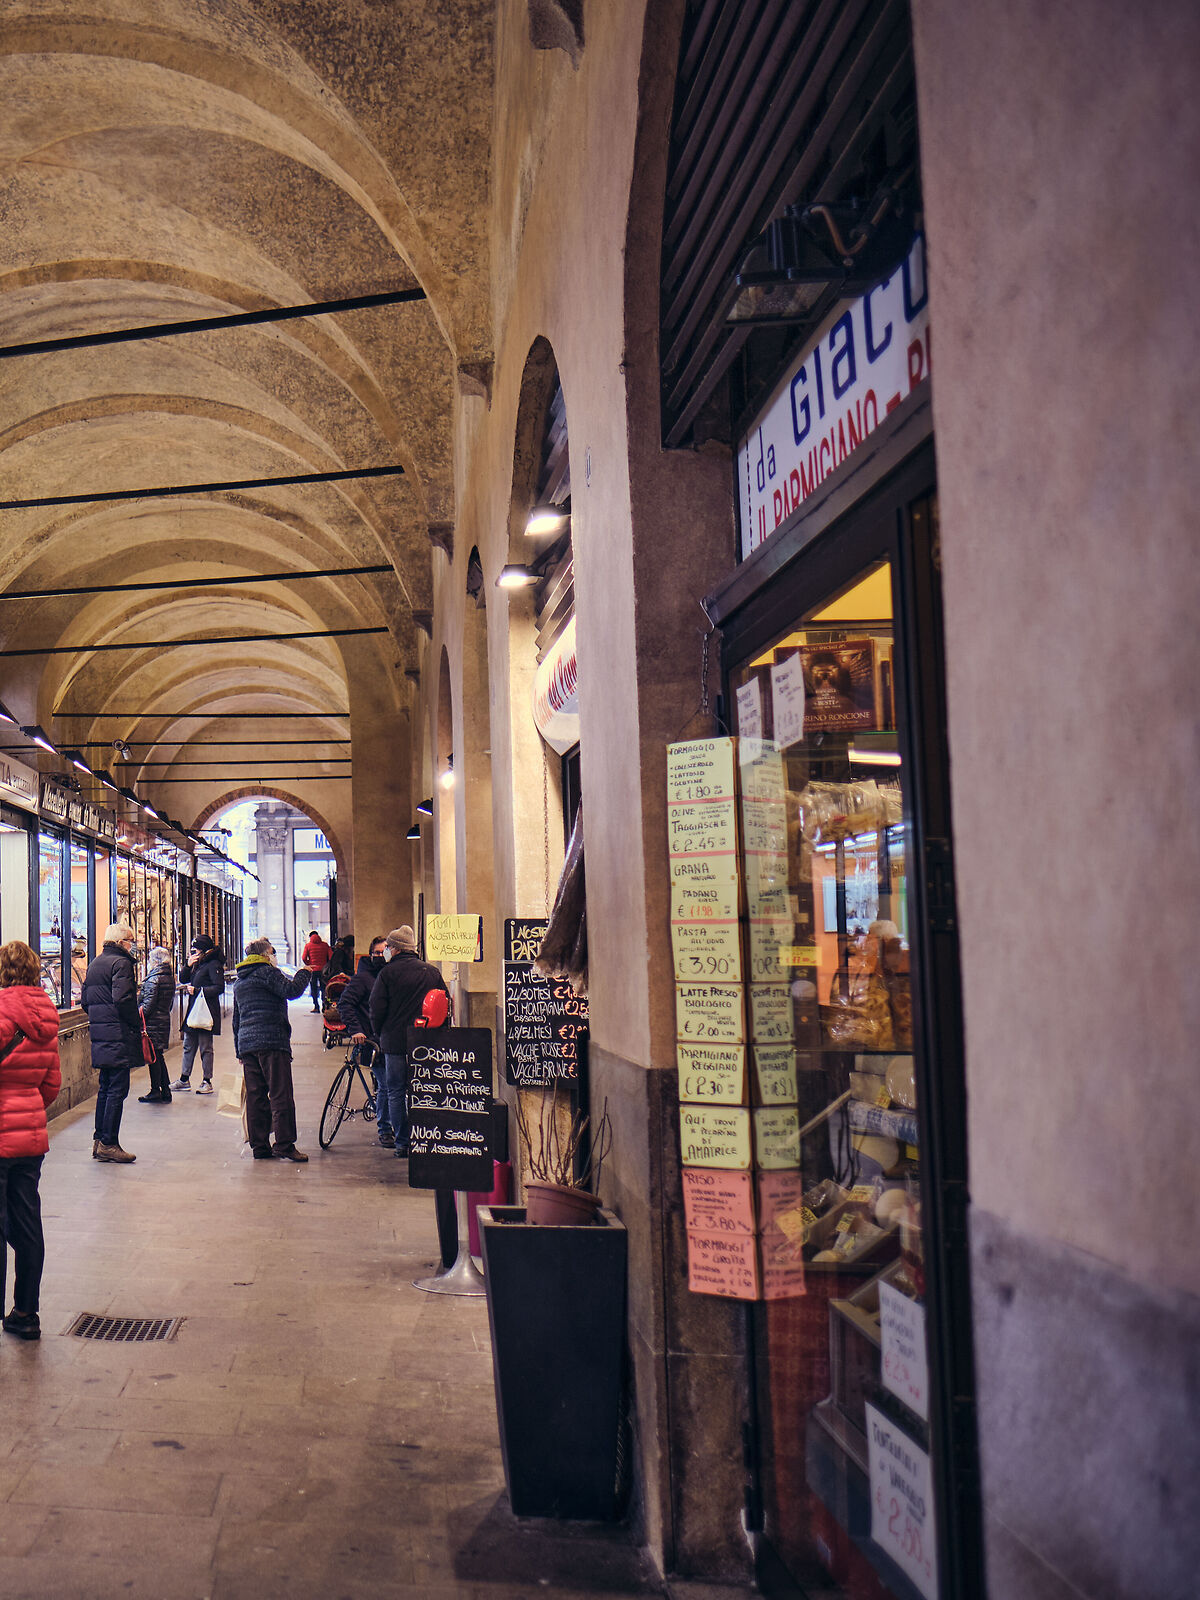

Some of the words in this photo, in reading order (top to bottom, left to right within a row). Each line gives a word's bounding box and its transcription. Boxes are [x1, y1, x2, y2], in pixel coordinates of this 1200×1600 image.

[756, 425, 777, 493] da
[772, 388, 880, 528] PARMIGIANO
[669, 743, 715, 756] FORMAGGIO
[674, 770, 705, 779] LATTOSIO
[674, 778, 703, 787] GLUTINE
[671, 808, 696, 818] OLIVE
[671, 820, 727, 834] TAGGIASCHE
[684, 837, 715, 852] 2.45
[674, 862, 709, 877] GRANA
[682, 889, 718, 898] PADANO
[677, 926, 707, 937] PASTA
[689, 956, 729, 975] 3.90
[680, 987, 708, 998] LATTE
[710, 986, 738, 998] FRESCO
[521, 1001, 566, 1016] MONTAGNA
[685, 999, 732, 1008] BIOLOGICO
[696, 1022, 719, 1037] 2.00
[412, 1045, 459, 1063] ORDINA
[462, 1051, 476, 1064] LA
[509, 1042, 539, 1058] VACCHE
[681, 1048, 738, 1061] PARMIGIANO
[410, 1063, 431, 1079] TUA
[433, 1063, 467, 1080] SPESA
[471, 1070, 483, 1079] E
[511, 1061, 541, 1079] VACCHE
[691, 1060, 738, 1072] REGGIANO
[410, 1078, 442, 1094] PASSA
[446, 1083, 454, 1095] A
[453, 1081, 491, 1096] RITIRARE
[696, 1076, 723, 1096] 2.30
[411, 1094, 438, 1108] DOPO
[441, 1095, 459, 1109] 10
[685, 1113, 705, 1125] QUI
[410, 1125, 442, 1140] NUOVO
[443, 1129, 485, 1143] SERVIZIO
[687, 1144, 737, 1160] AMATRICE
[690, 1235, 745, 1253] FORMAGGI
